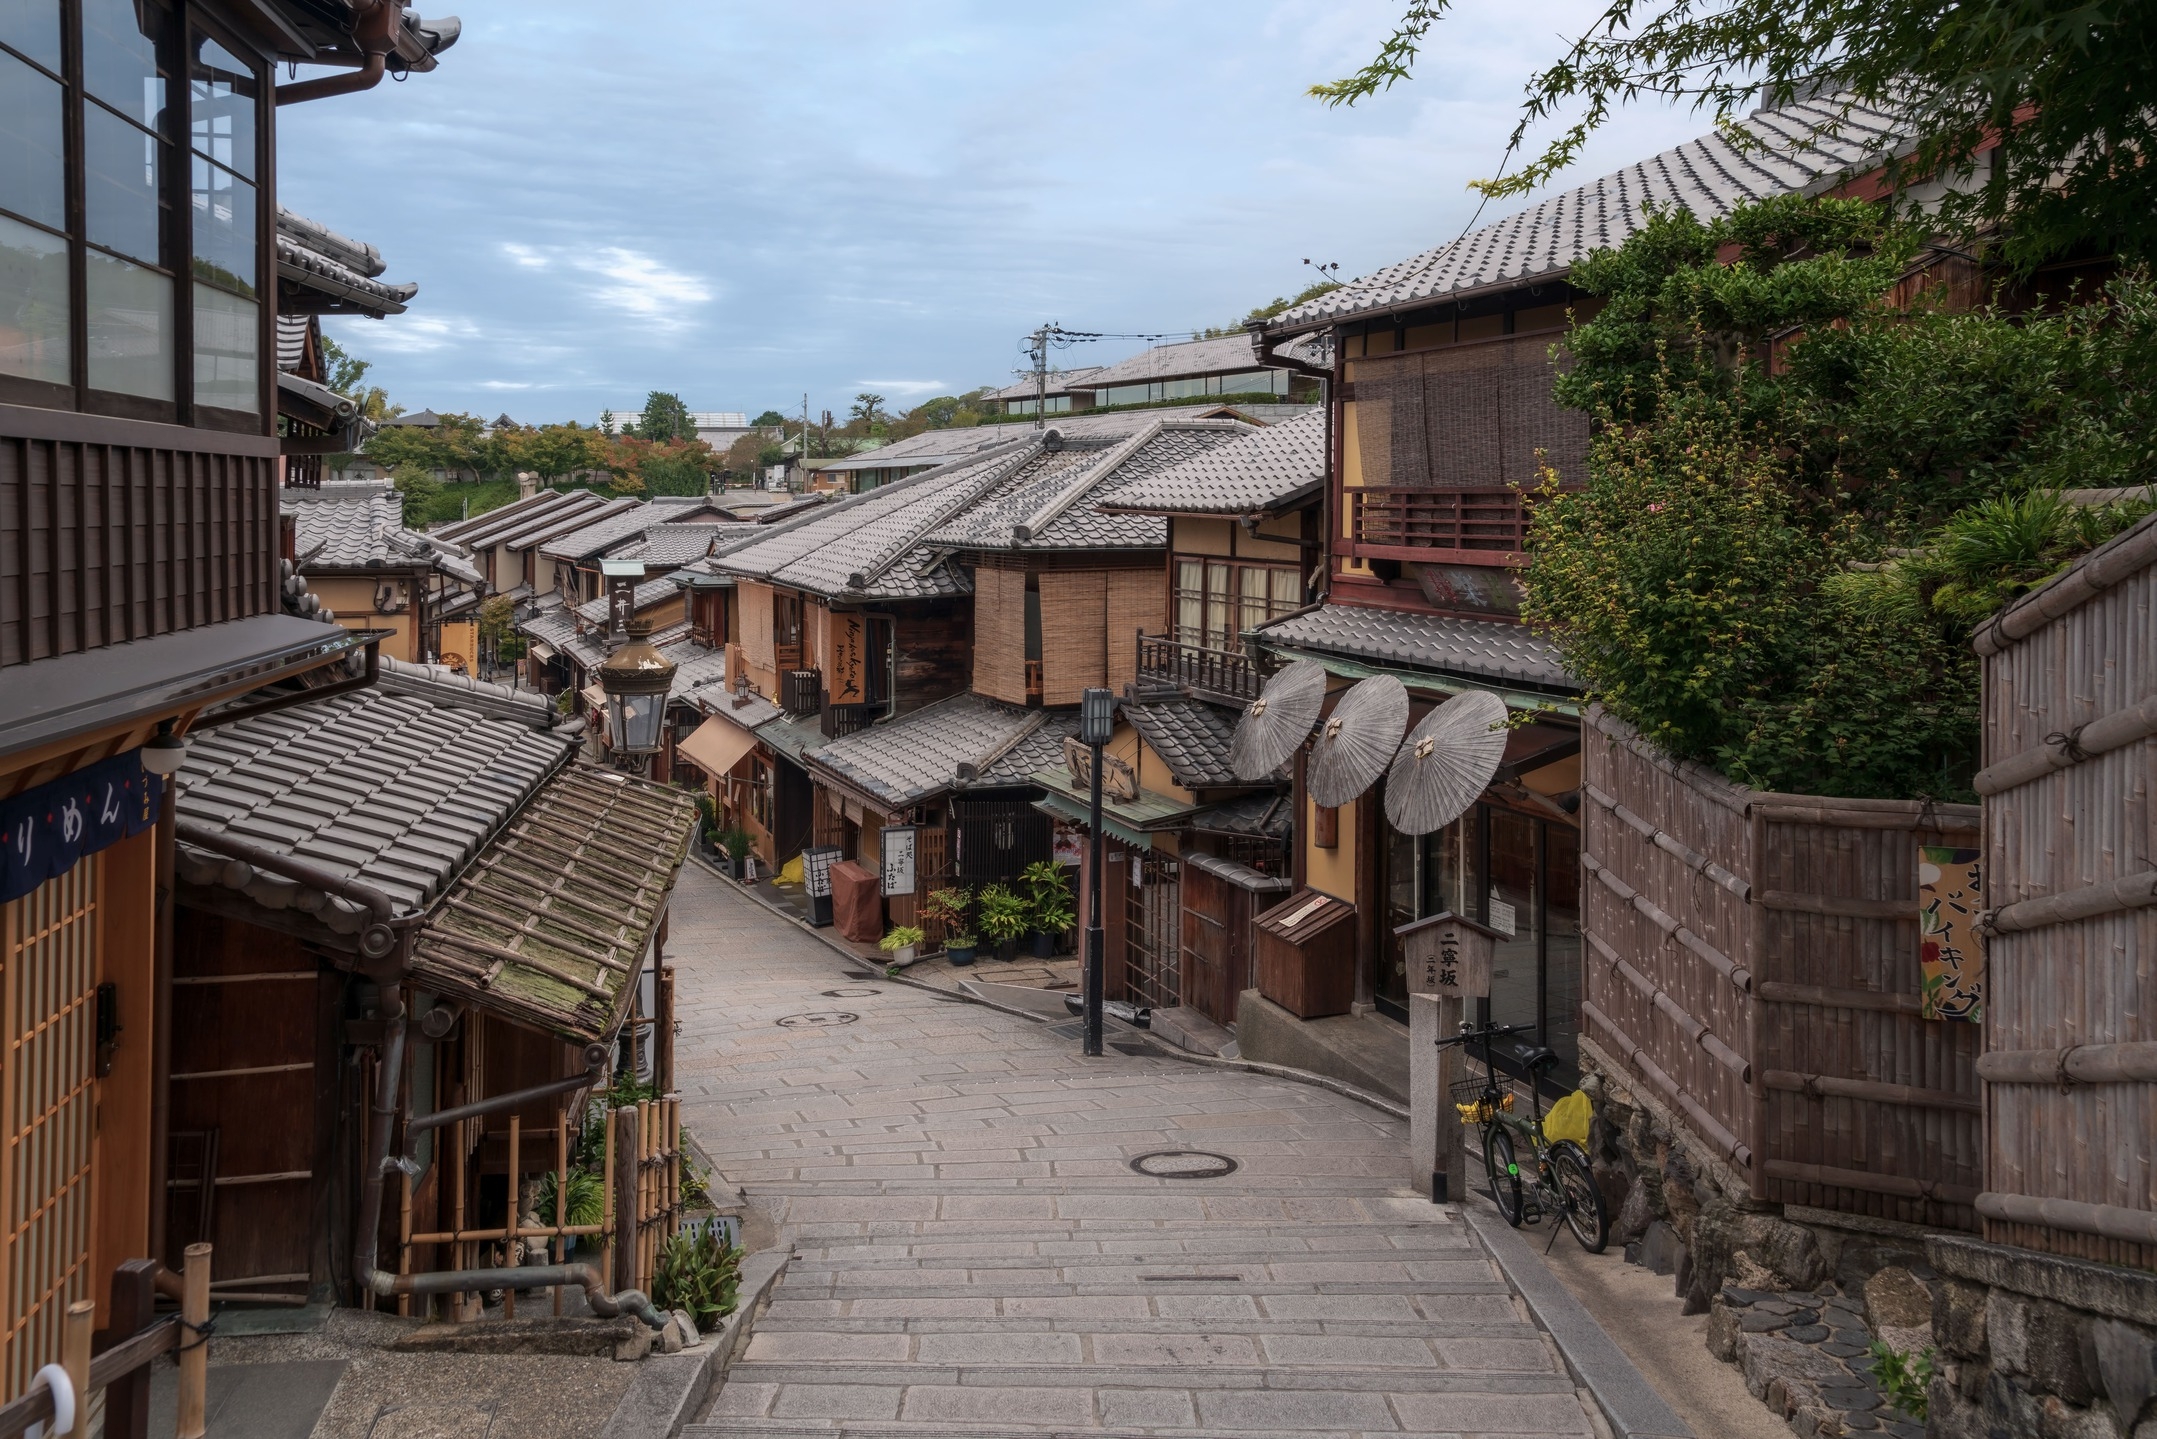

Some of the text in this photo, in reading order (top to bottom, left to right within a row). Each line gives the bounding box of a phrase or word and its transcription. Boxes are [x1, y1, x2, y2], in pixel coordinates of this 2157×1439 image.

[886, 863, 897, 890] ふたば
[1425, 954, 1436, 987] （二年坂）
[1439, 932, 1460, 987] 二寧坂
[1926, 890, 1982, 1017] バイキング
